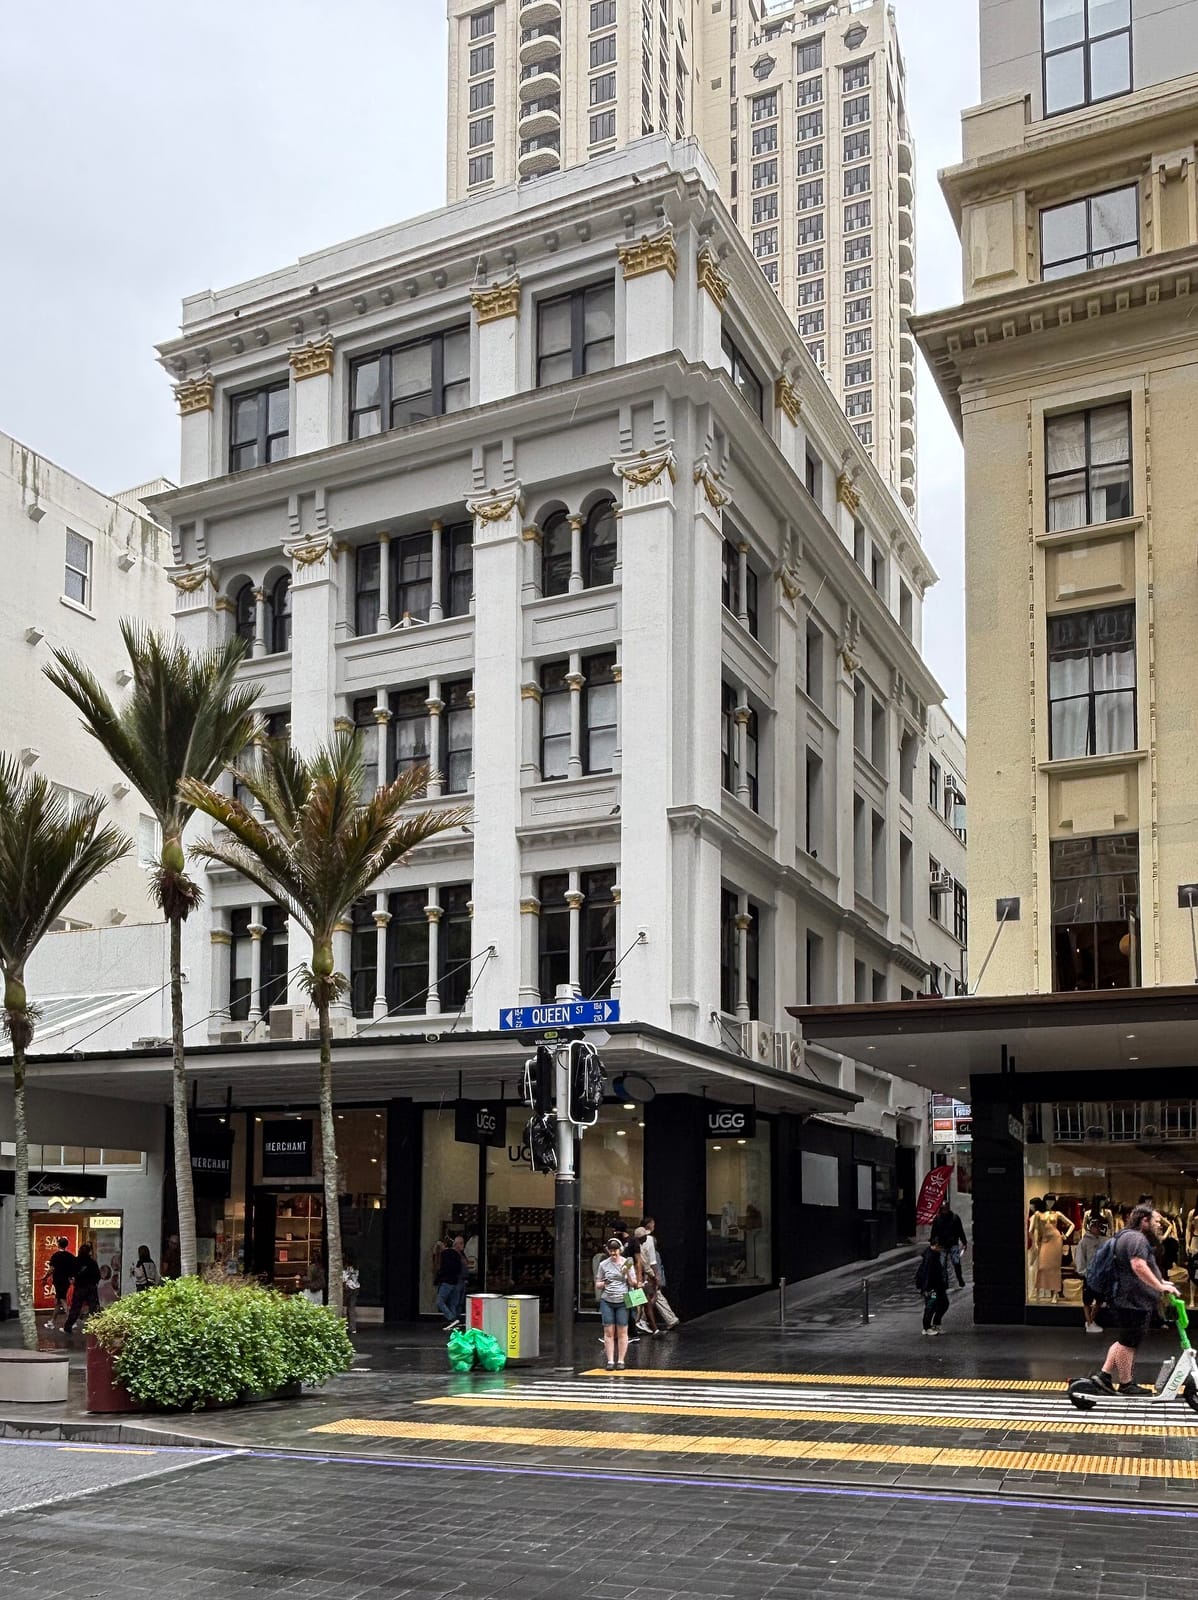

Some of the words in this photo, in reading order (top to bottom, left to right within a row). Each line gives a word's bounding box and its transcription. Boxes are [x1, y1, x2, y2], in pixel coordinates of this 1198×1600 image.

[532, 1006, 570, 1024] QUEEN
[575, 1005, 583, 1015] ST
[476, 1113, 496, 1130] UGG
[708, 1113, 745, 1128] UGG
[265, 1141, 306, 1151] MERCHANT
[192, 1157, 230, 1169] MERCHANT
